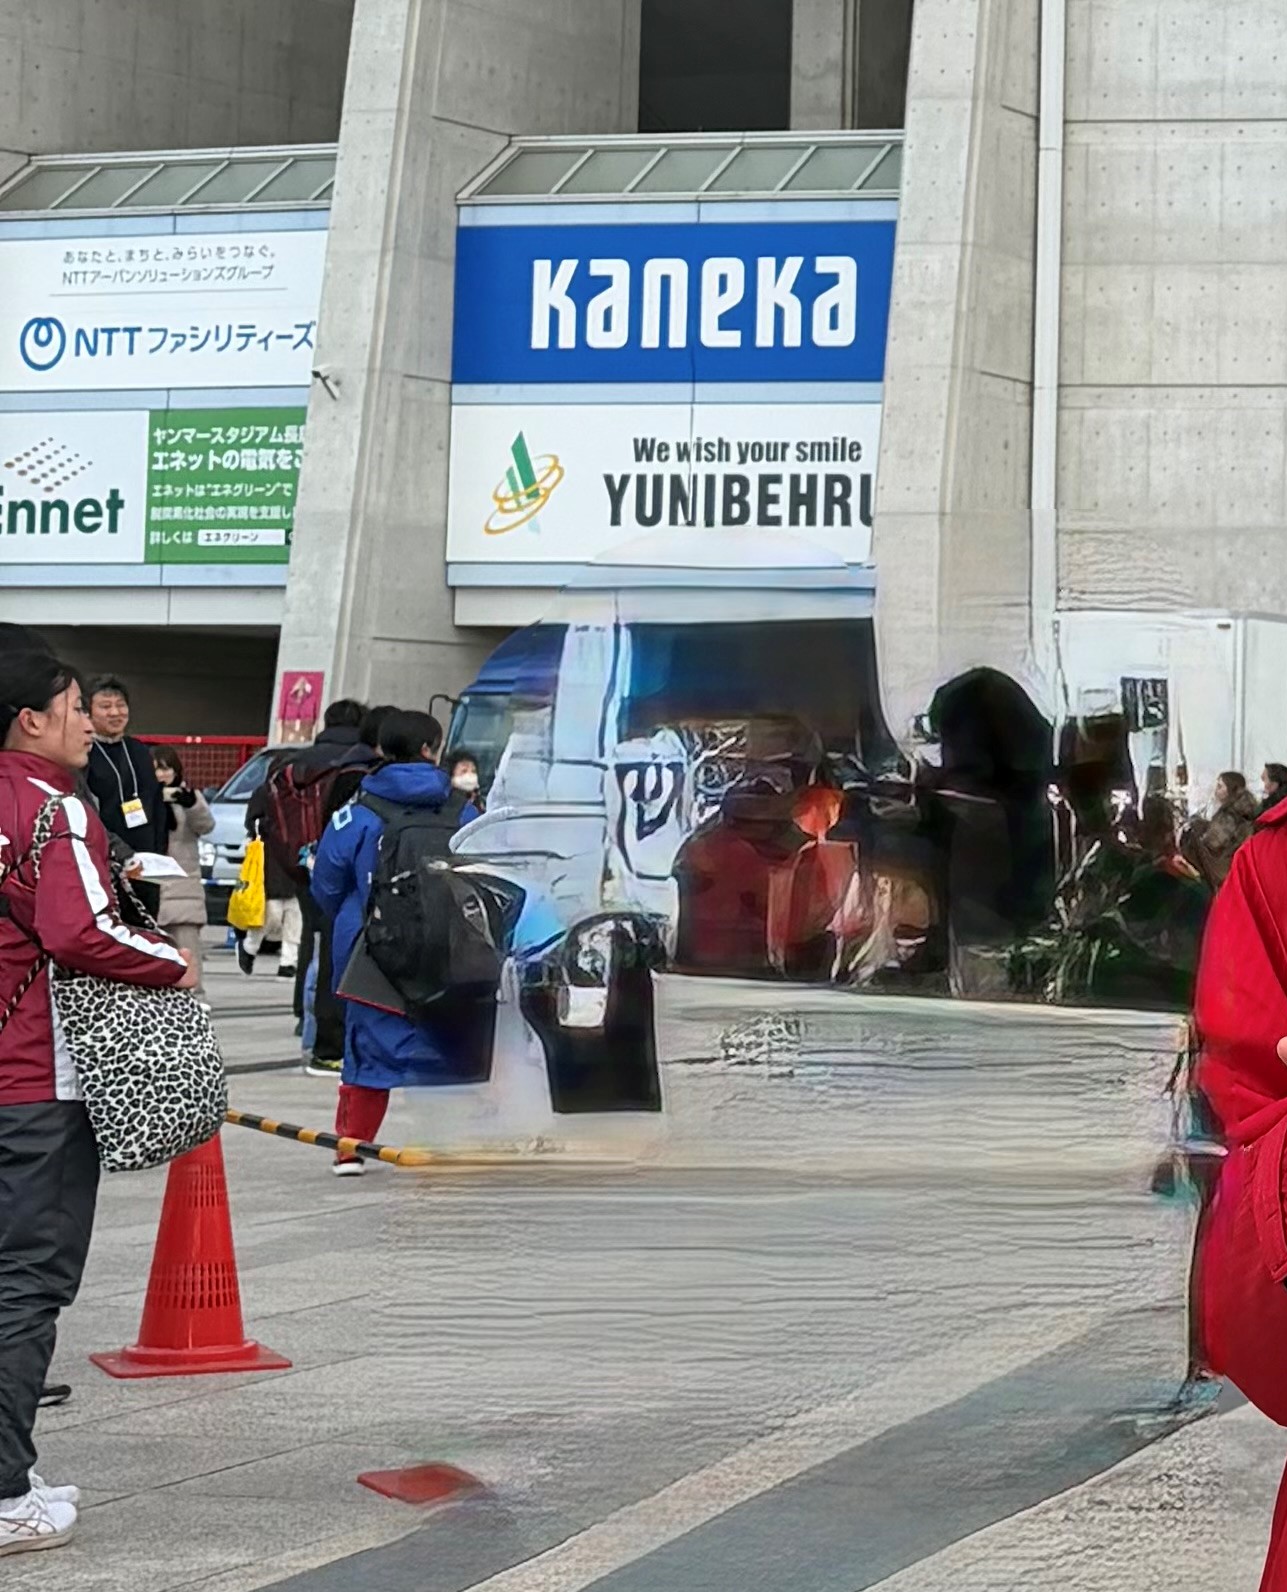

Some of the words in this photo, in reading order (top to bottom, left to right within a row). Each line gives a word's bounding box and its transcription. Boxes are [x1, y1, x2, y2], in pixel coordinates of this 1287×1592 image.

[153, 425, 305, 445] ヤンマースタジアム長
[633, 438, 668, 463] We
[676, 437, 731, 462] wish
[737, 439, 791, 465] your
[795, 436, 863, 462] smile
